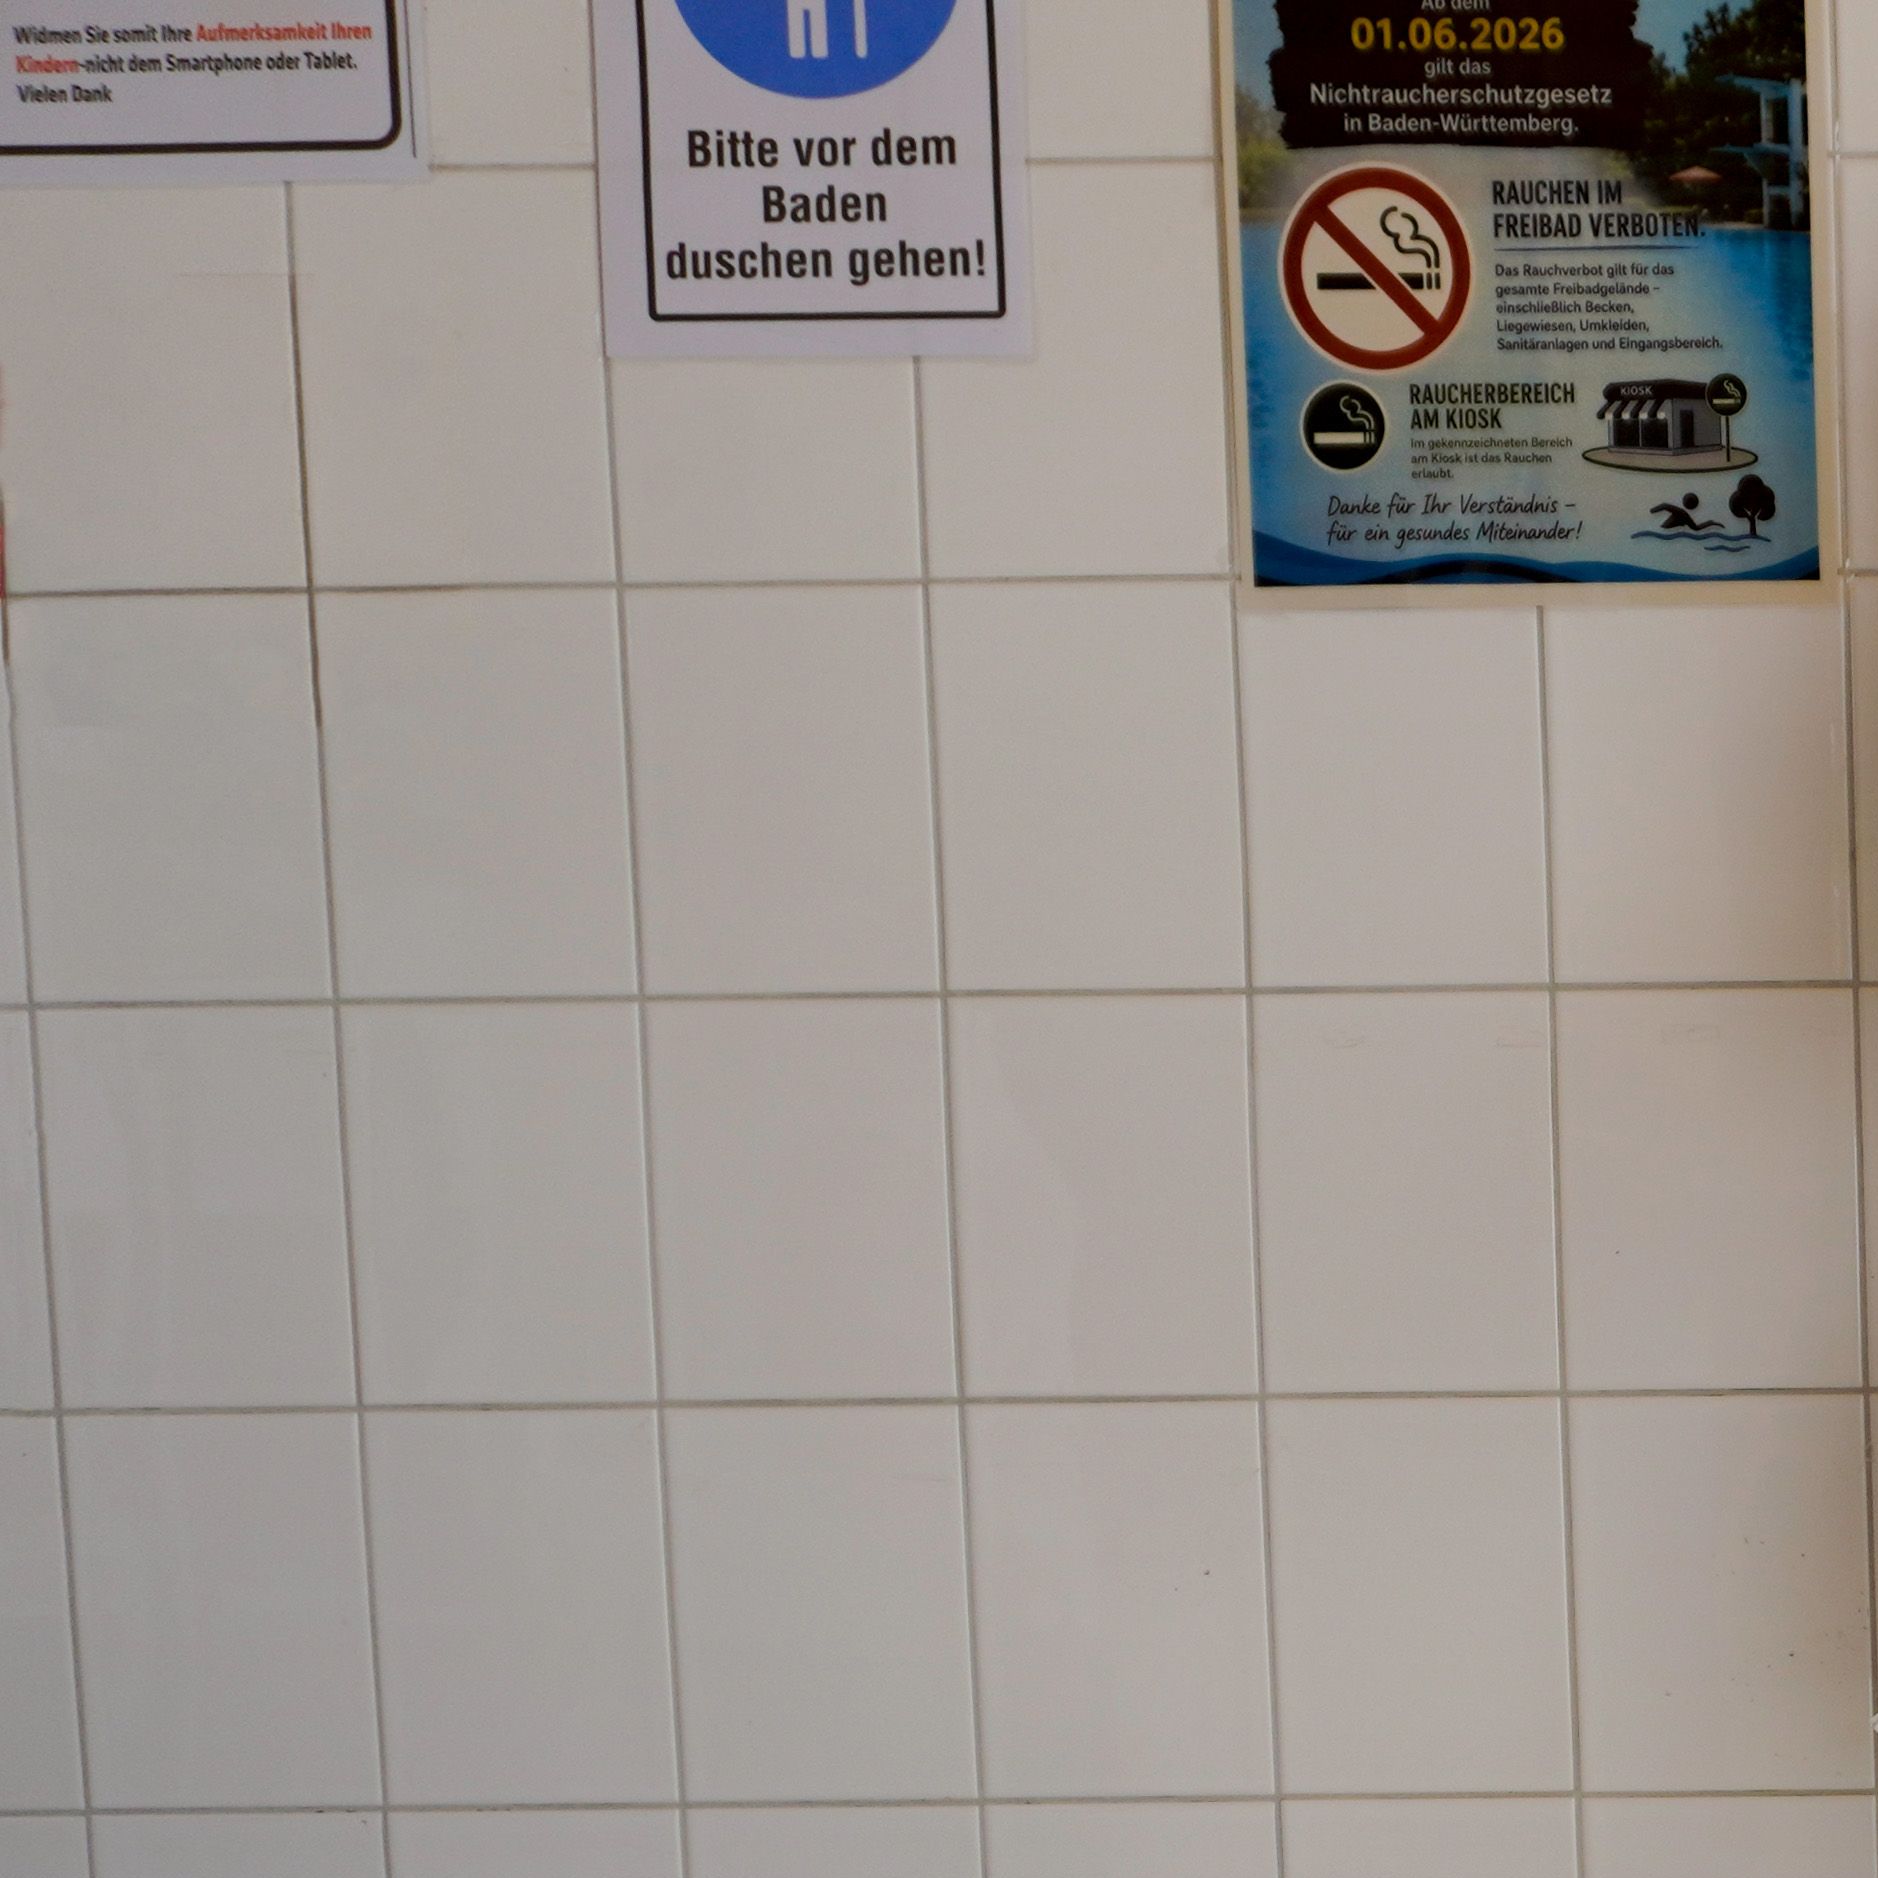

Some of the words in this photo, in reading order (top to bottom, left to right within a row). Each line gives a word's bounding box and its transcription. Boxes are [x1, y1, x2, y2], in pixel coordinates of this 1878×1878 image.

[12, 25, 82, 45] Widmen
[86, 25, 110, 44] Sie
[113, 25, 158, 43] somit
[161, 24, 192, 43] Ihre
[196, 23, 328, 42] Aufmerksamkeit
[331, 23, 372, 41] Ihren
[1350, 16, 1566, 51] 01.06.2026
[128, 53, 162, 73] dem
[166, 53, 262, 76] Smartphone
[266, 52, 301, 71] oder
[303, 51, 357, 71] Tablet.
[1424, 57, 1454, 79] gilt
[1459, 57, 1491, 75] das
[17, 84, 68, 104] Vielen
[72, 84, 113, 103] Dank
[1309, 82, 1613, 111] Nichtraucherschutzgesetz
[1343, 113, 1362, 132] in
[1368, 112, 1579, 137] Baden-Württemberg.
[687, 129, 779, 168] Bitte
[793, 136, 856, 167] vor
[871, 127, 956, 166] dem
[762, 184, 888, 223] Baden
[1492, 180, 1590, 205] RAUCHEN
[1598, 180, 1622, 204] IM
[1493, 213, 1581, 238] FREIBAD
[1588, 212, 1706, 238] VERBOTEN.
[666, 241, 833, 279] duschen
[848, 238, 986, 287] gehen!
[1409, 382, 1575, 405] RAUCHERBEREICH
[1410, 409, 1440, 430] AM
[1445, 408, 1502, 430] KIOSK
[1327, 495, 1381, 517] Danke
[1387, 493, 1416, 518] für
[1421, 493, 1452, 516] Ihr
[1460, 493, 1558, 516] Verständnis
[1327, 521, 1355, 546] für
[1364, 524, 1389, 541] ein
[1395, 521, 1470, 549] gesundes
[1475, 520, 1583, 542] Miteinander!
